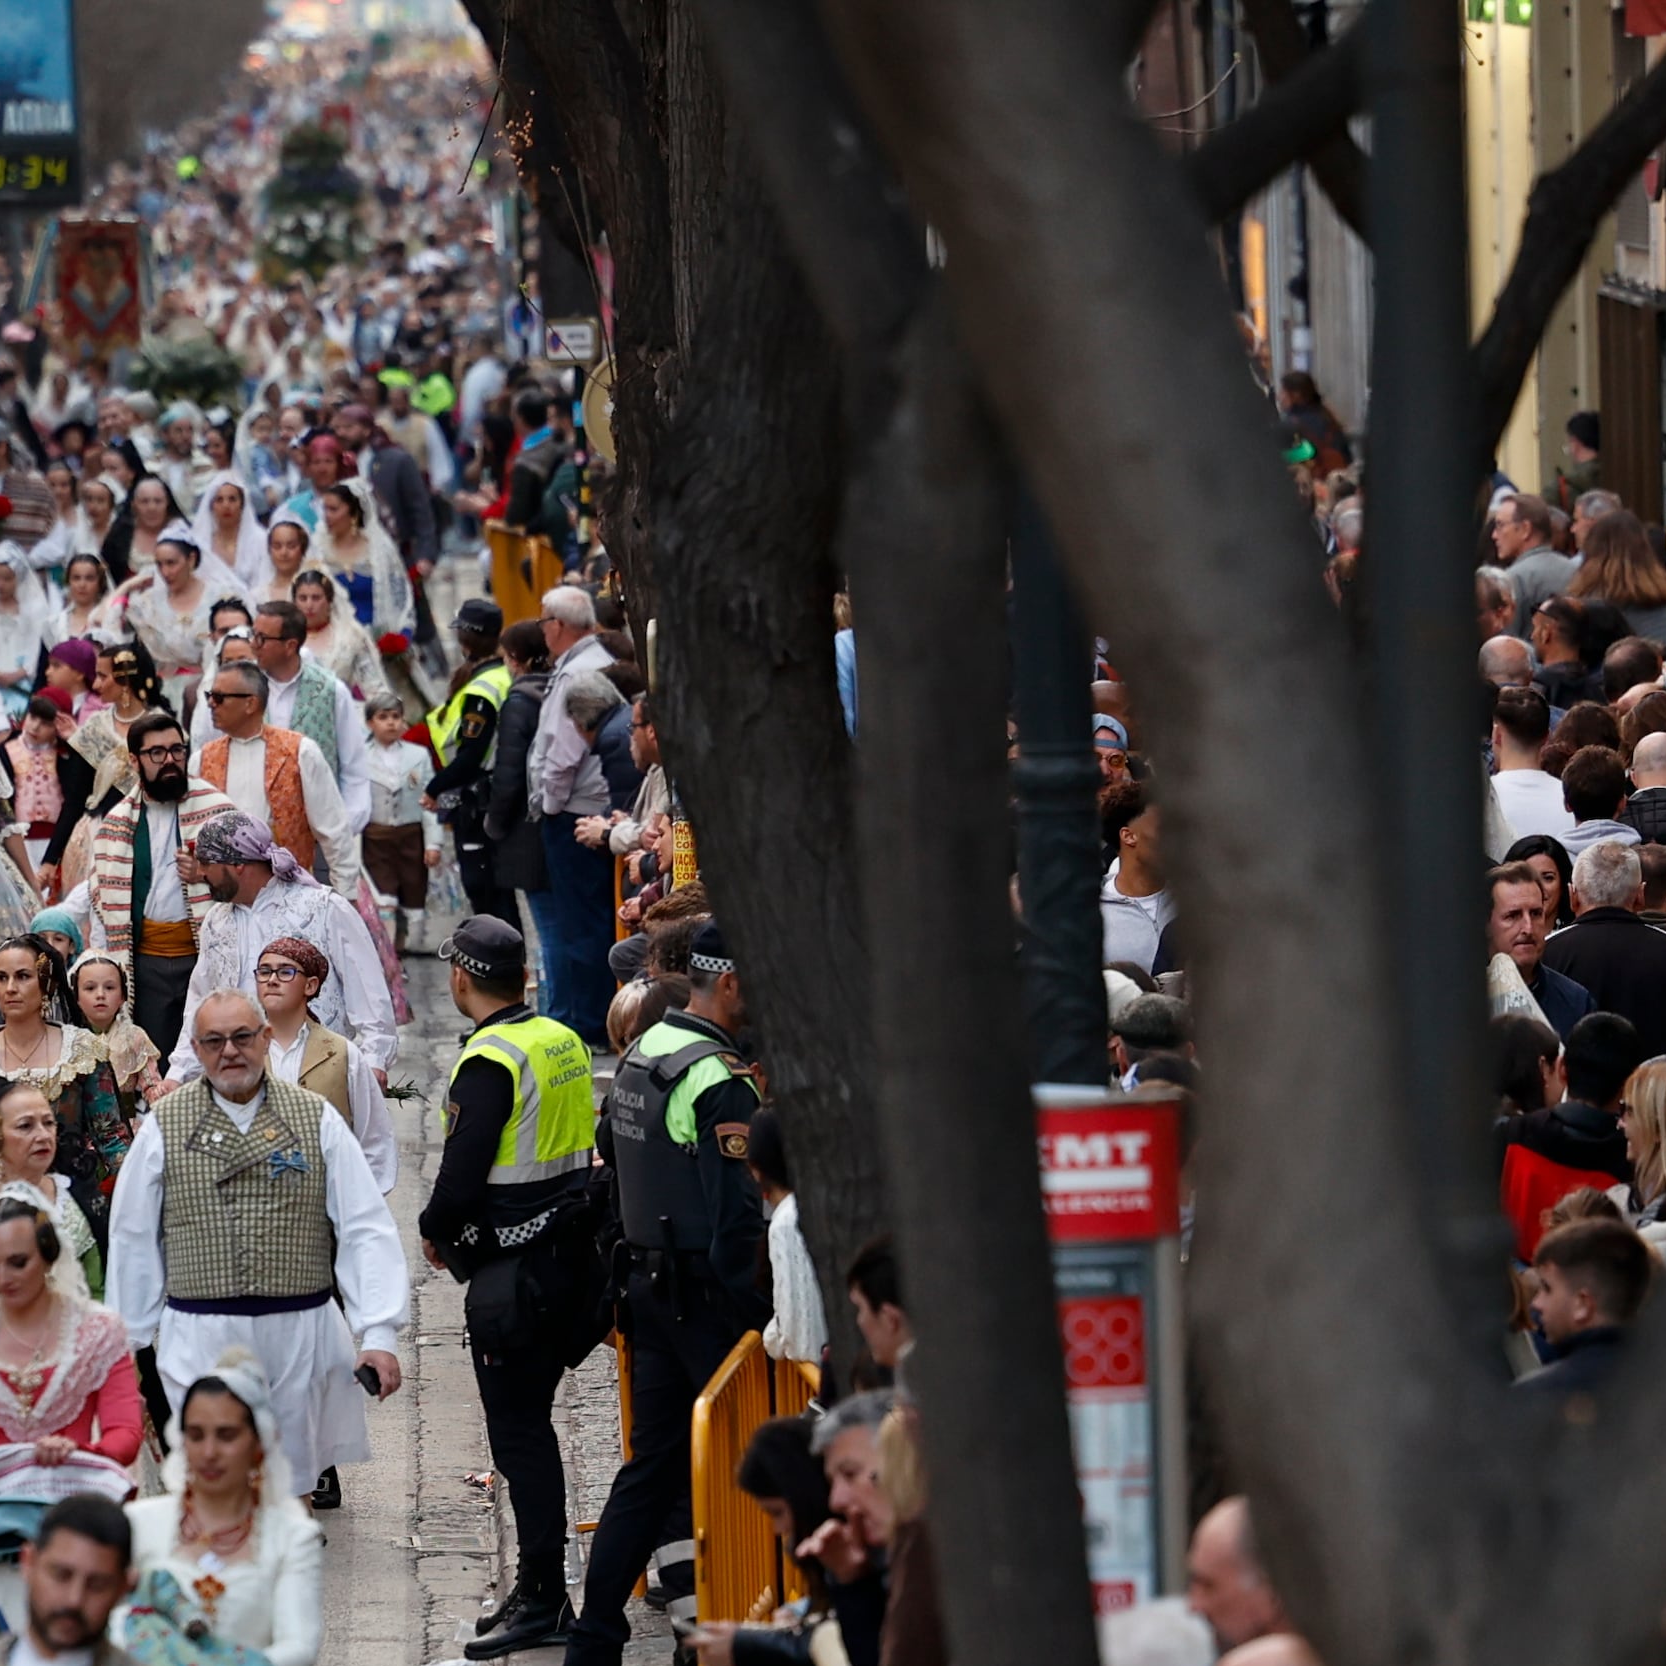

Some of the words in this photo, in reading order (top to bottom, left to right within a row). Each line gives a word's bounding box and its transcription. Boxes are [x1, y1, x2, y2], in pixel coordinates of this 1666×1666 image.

[544, 1039, 576, 1059] POLICIA
[548, 1064, 589, 1089] VALENCIA
[613, 1086, 646, 1111] POLICIA
